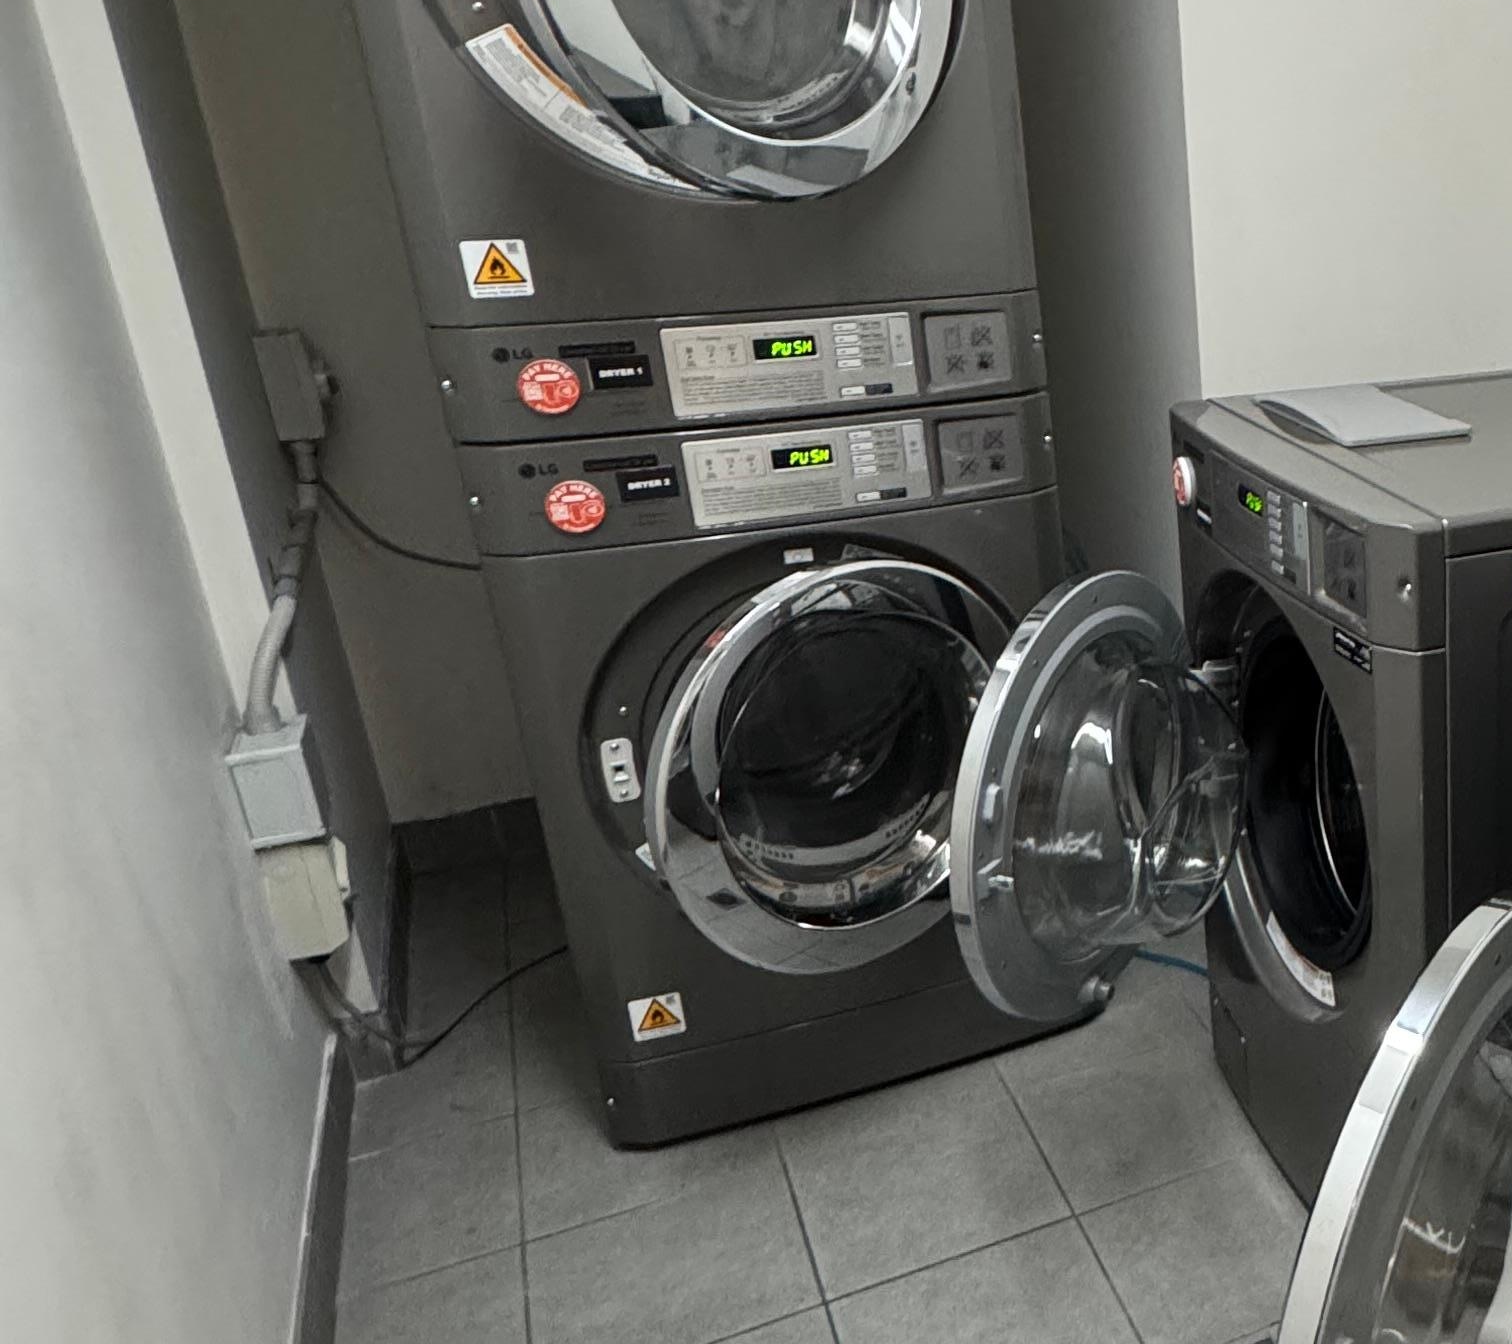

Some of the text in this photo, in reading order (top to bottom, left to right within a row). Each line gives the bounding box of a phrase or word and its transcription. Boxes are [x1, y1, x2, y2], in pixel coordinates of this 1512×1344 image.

[771, 340, 813, 357] PUSH
[521, 363, 573, 381] PAY HERE
[598, 366, 643, 379] DRYER 1
[789, 448, 830, 466] PUSH
[627, 478, 671, 491] DRYER 2
[549, 485, 600, 502] PAY HERE
